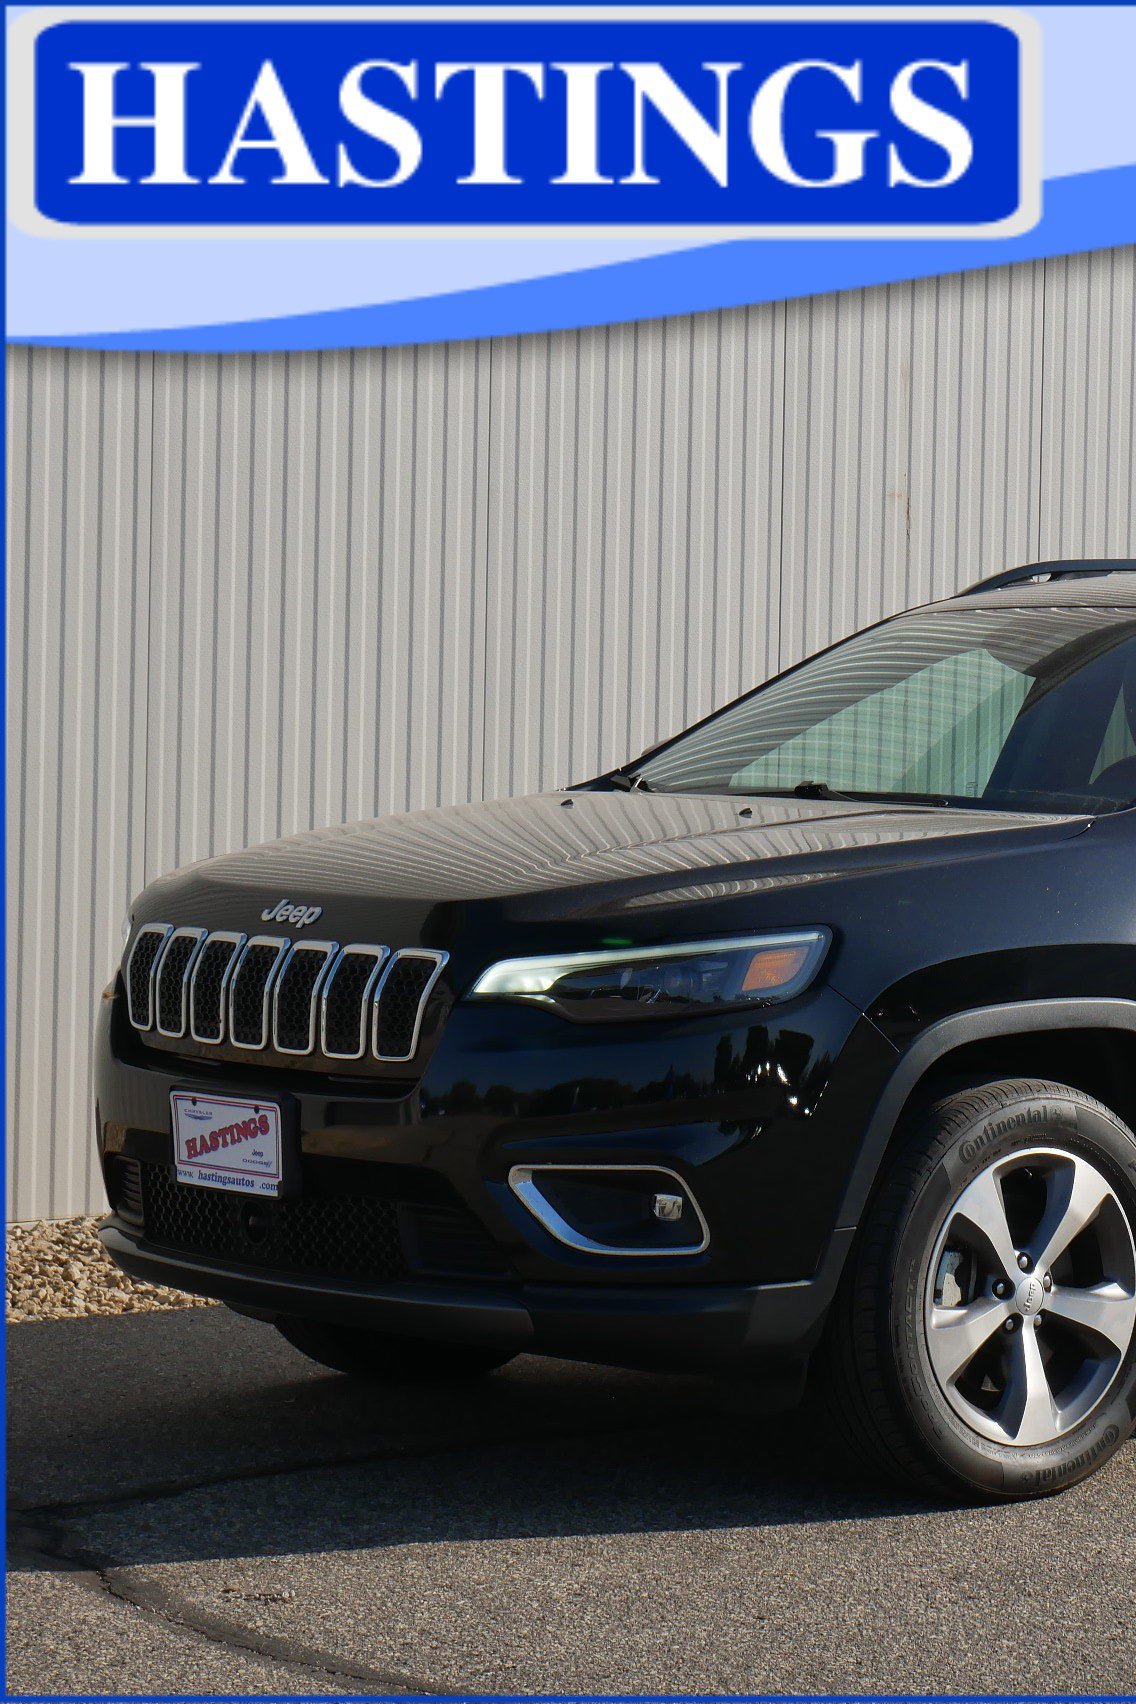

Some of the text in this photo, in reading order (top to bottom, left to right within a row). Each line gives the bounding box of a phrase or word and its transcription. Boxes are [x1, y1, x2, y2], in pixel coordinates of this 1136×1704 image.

[261, 898, 322, 929] Jeep
[184, 1114, 270, 1160] HASTINGS
[251, 1148, 264, 1159] Jeep
[198, 1170, 255, 1188] hastingsautos
